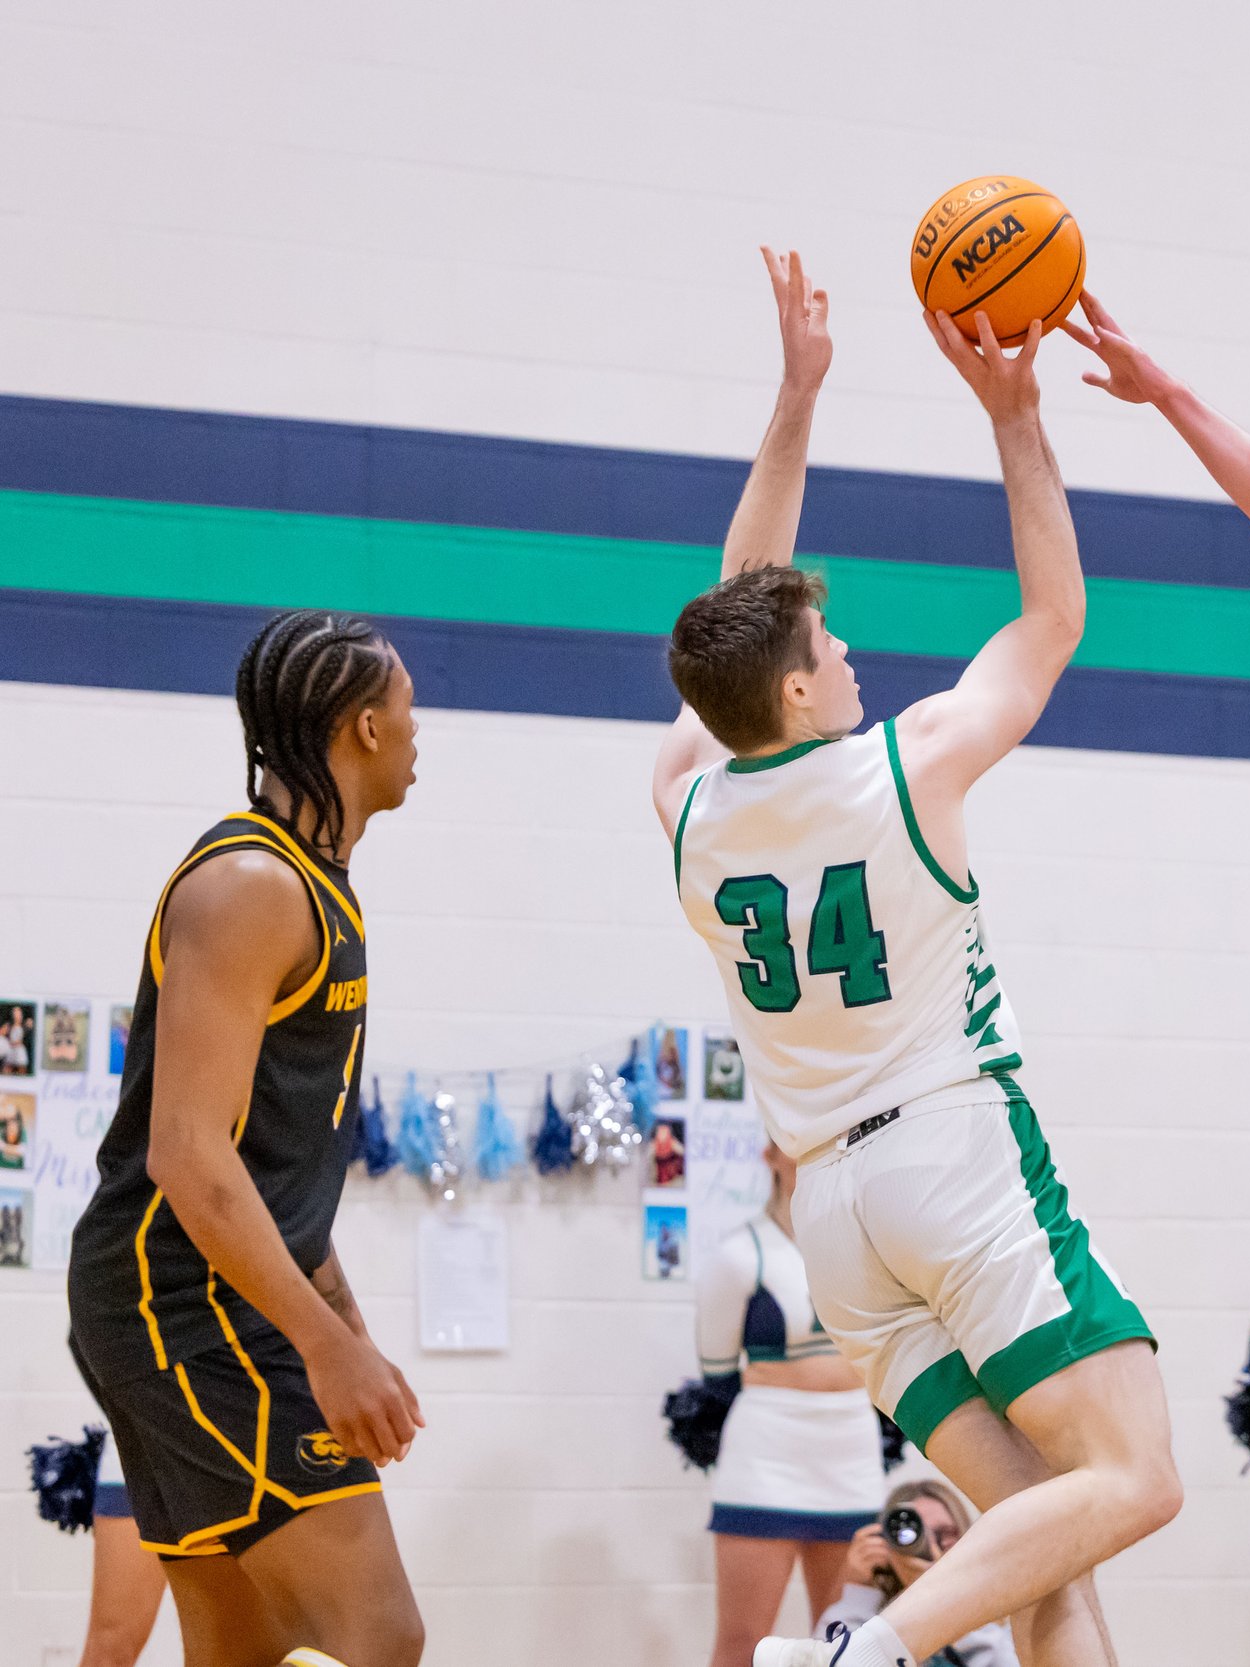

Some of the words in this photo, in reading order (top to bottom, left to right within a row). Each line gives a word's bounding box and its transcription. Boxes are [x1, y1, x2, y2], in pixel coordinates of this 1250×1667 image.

[914, 179, 1010, 260] Wilson
[951, 213, 1027, 284] NCAA
[713, 859, 892, 1012] 34
